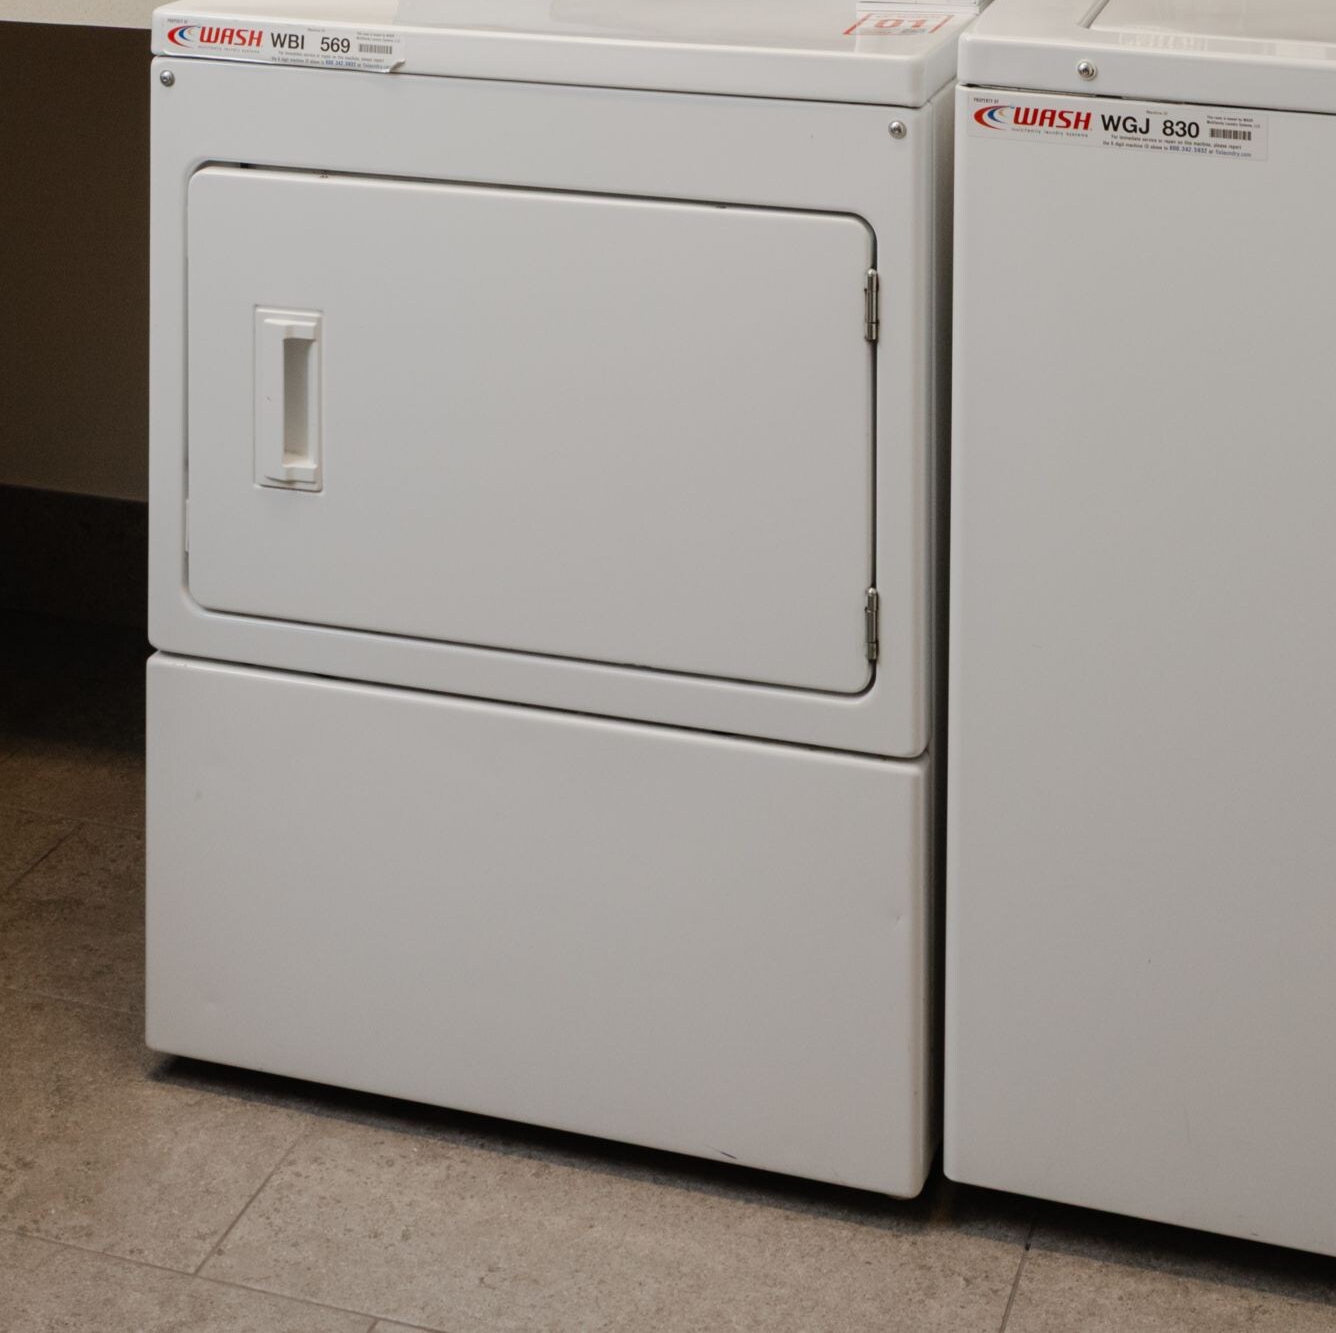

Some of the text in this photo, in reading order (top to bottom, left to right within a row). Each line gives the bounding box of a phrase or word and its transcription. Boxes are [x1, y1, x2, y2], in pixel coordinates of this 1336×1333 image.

[200, 26, 263, 47] WASH
[270, 32, 305, 50] WBI
[320, 36, 351, 54] 569
[1013, 107, 1092, 130] WASH
[1101, 114, 1200, 138] WGJ 830
